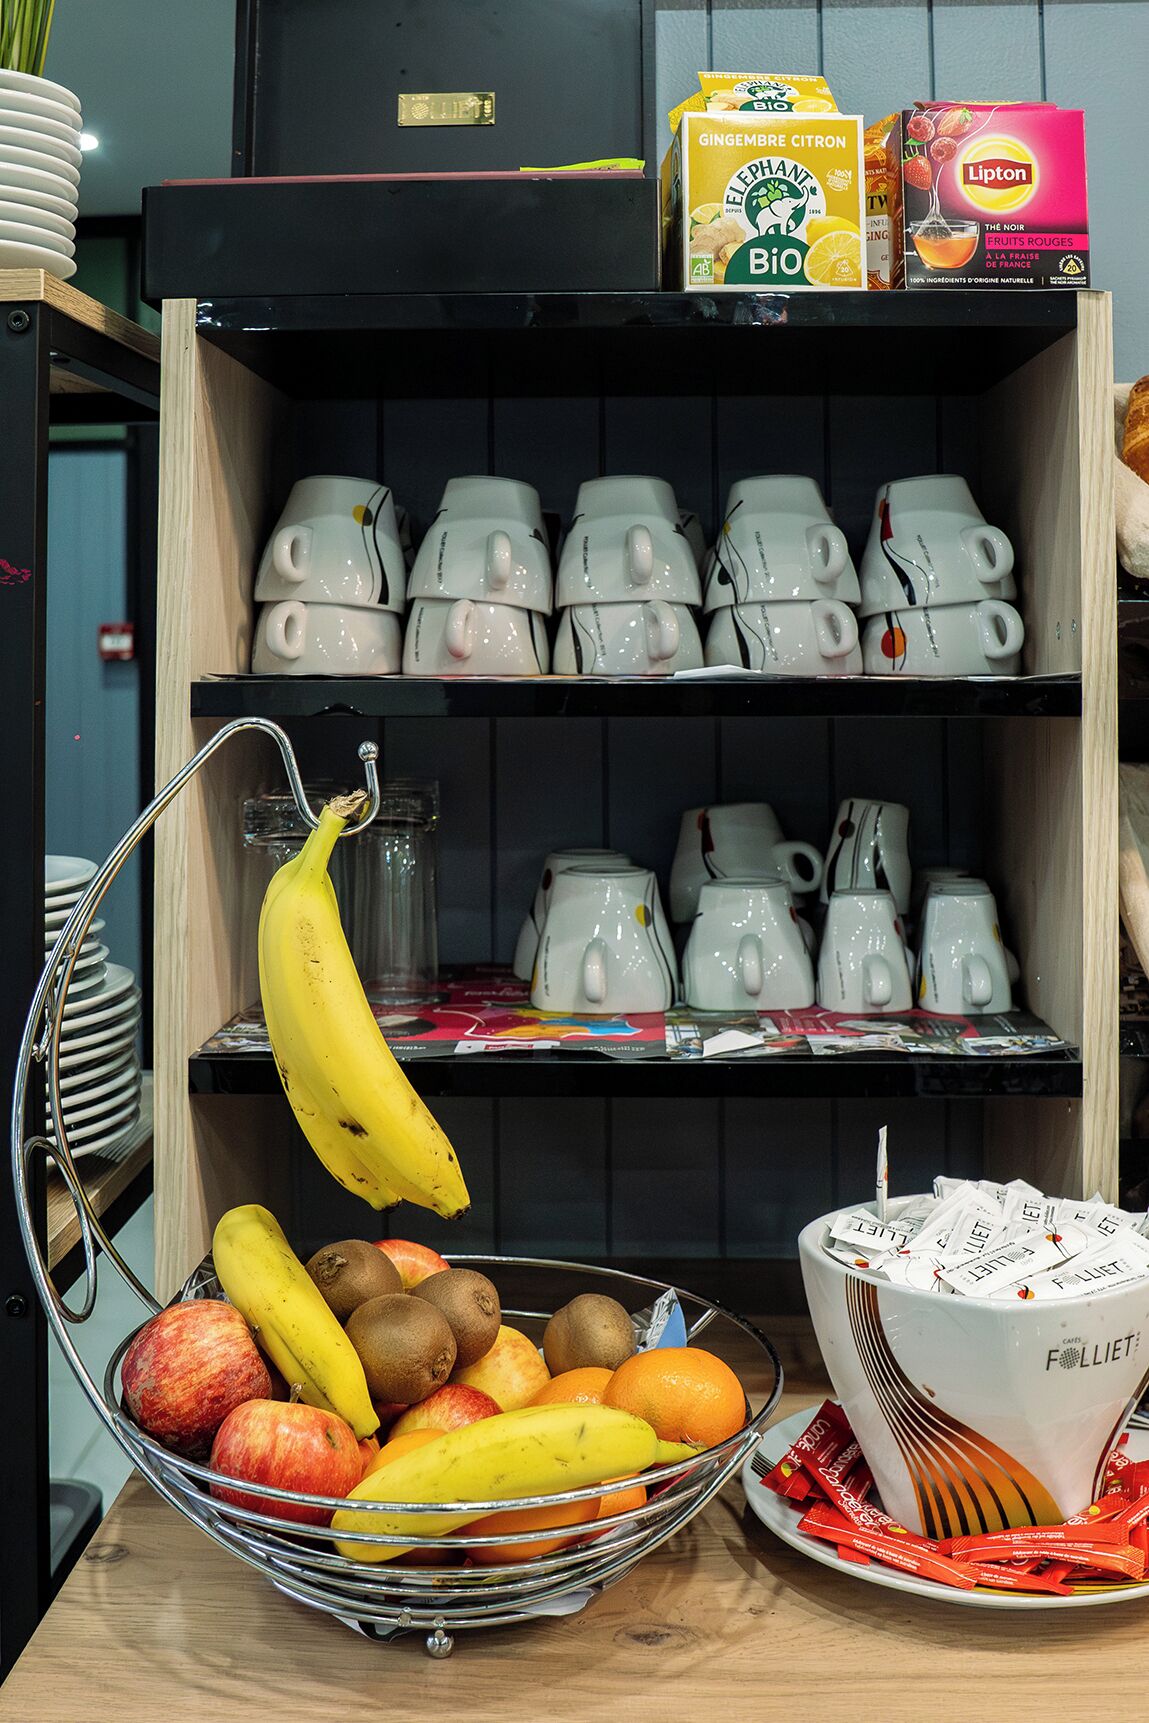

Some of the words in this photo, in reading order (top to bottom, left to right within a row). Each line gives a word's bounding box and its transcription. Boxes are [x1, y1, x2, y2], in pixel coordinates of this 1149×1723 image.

[699, 133, 786, 148] GINGEMBRE
[791, 134, 846, 148] CITRON
[968, 166, 1027, 184] Lipton
[726, 159, 814, 206] ELEPHANT
[985, 223, 1001, 231] THÉ
[988, 237, 1024, 246] FRUITS
[1028, 238, 1074, 246] ROUGES
[750, 248, 801, 274] BiO
[1067, 264, 1077, 272] 20
[692, 262, 710, 276] AB
[926, 276, 966, 284] INGRÉDIENTS
[1046, 1334, 1135, 1371] FOLLIET
